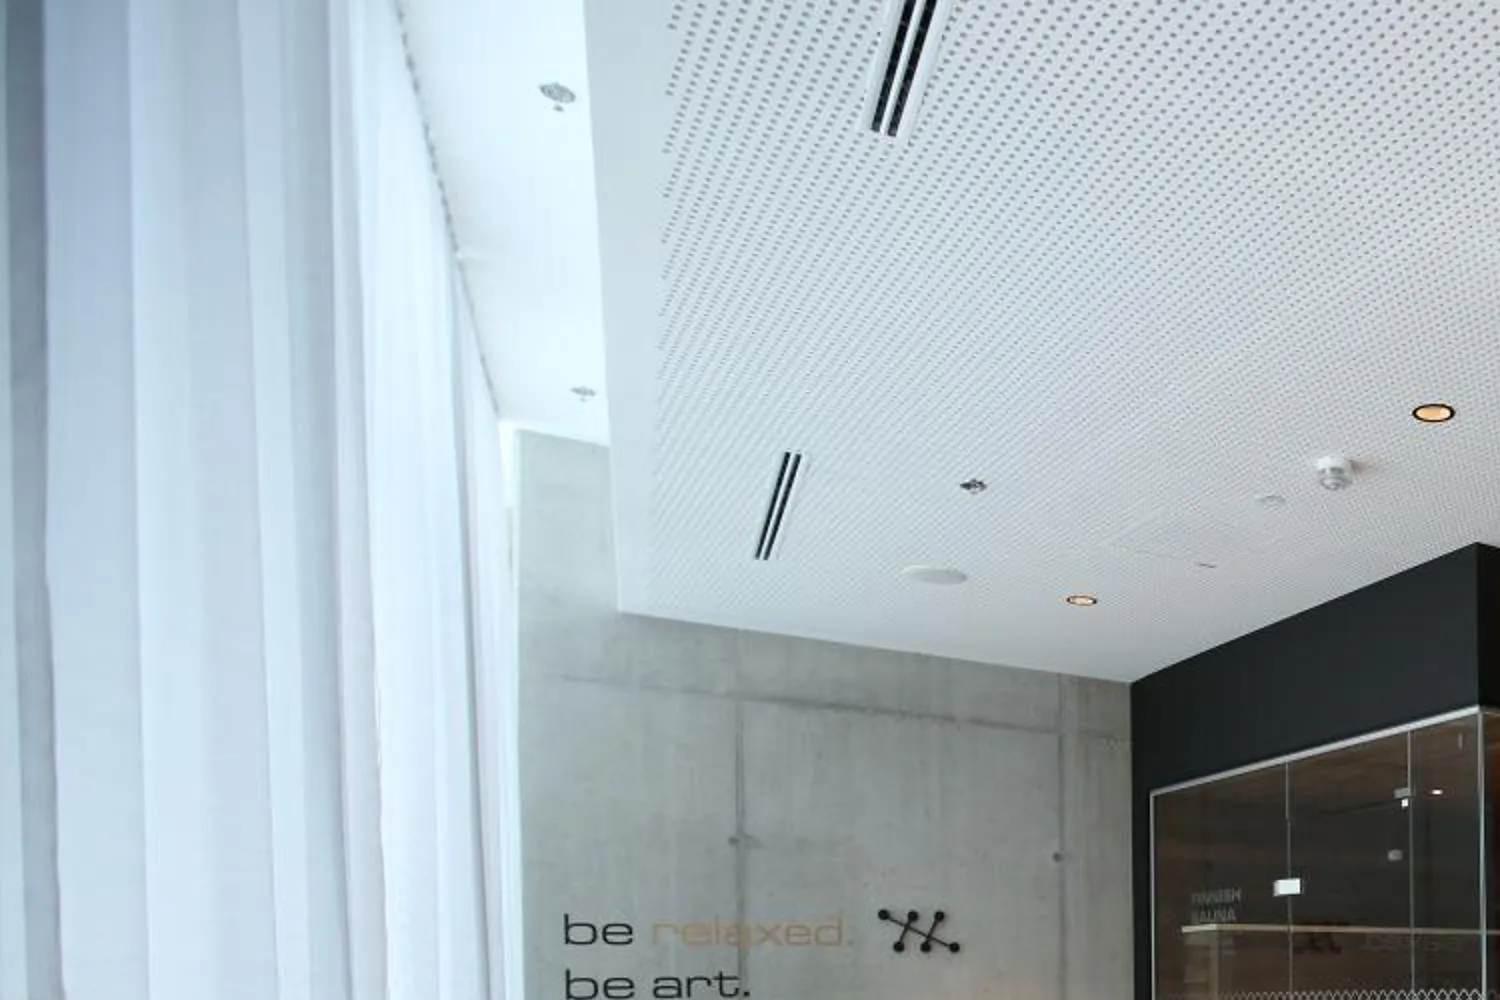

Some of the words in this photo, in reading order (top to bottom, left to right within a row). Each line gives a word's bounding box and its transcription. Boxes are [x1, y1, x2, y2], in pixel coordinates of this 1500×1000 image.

[563, 914, 634, 946] be
[651, 914, 854, 947] relaxed.
[564, 969, 635, 1000] be
[652, 971, 750, 999] art.
